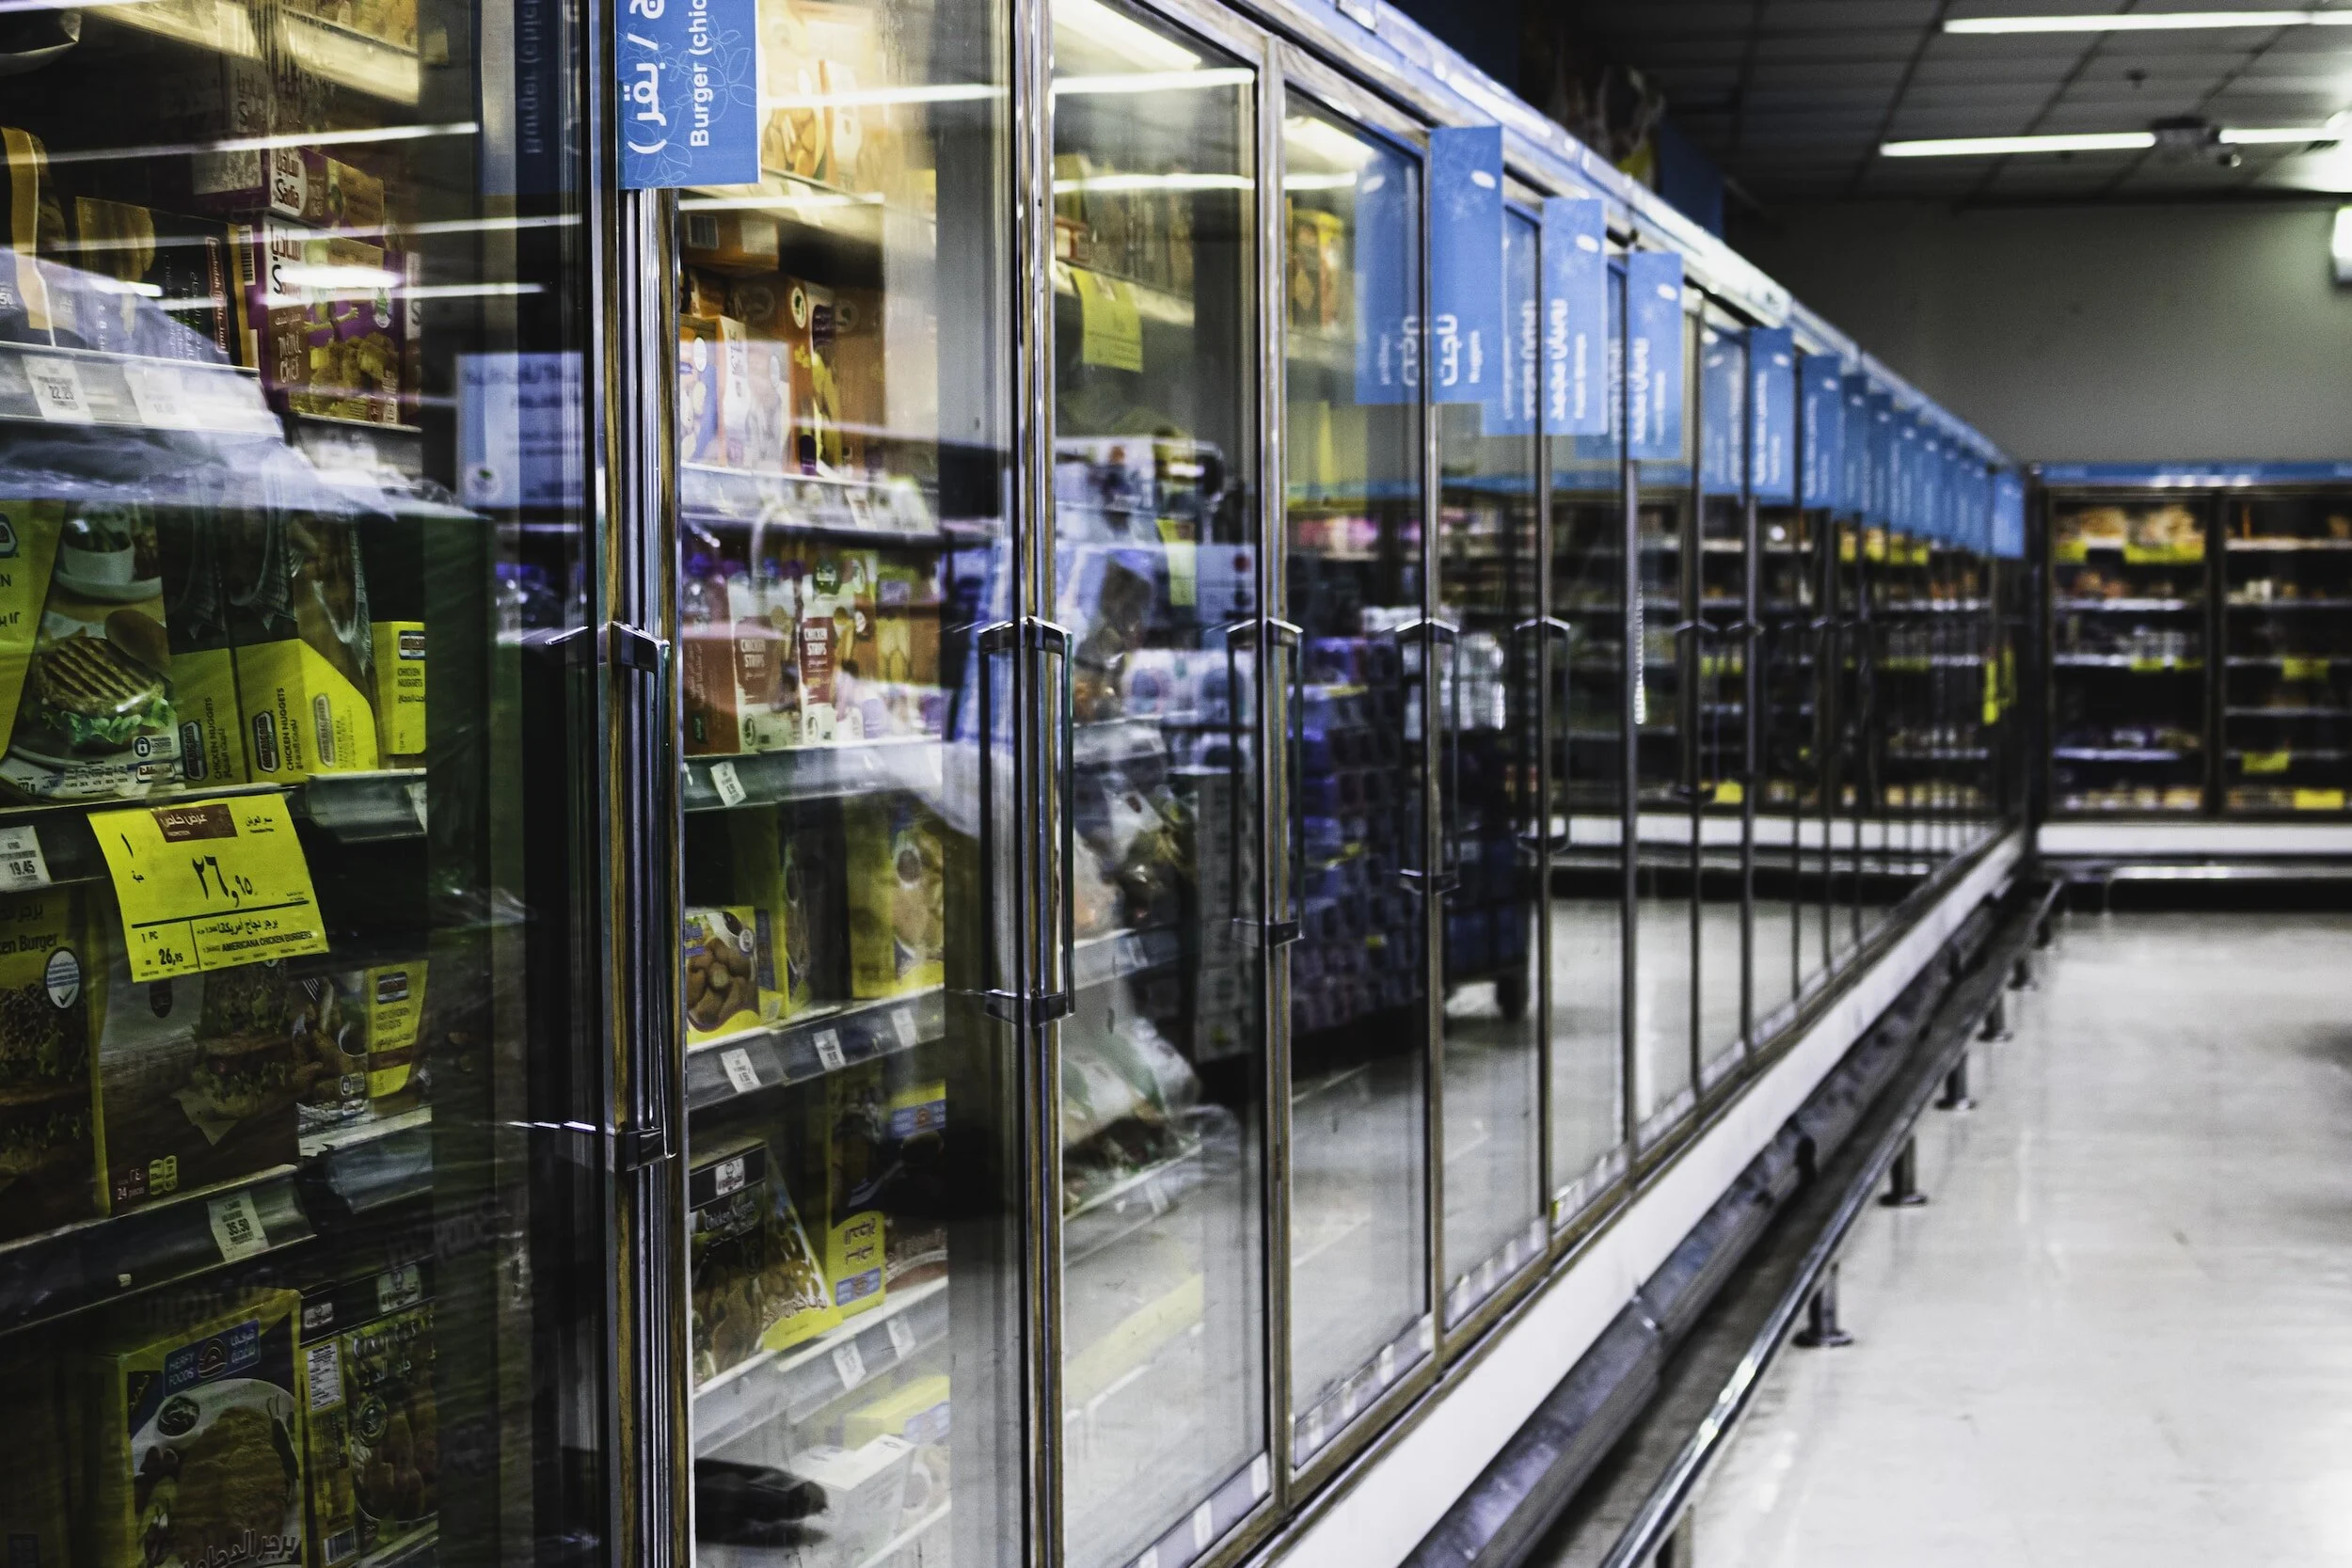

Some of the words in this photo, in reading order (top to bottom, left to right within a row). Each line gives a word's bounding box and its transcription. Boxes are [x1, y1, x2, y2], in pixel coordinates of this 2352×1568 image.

[624, 63, 667, 127] بقر
[691, 62, 713, 147] Burger
[277, 688, 289, 730] NUGGETS
[282, 733, 294, 771] CHICKEN
[160, 813, 184, 828] خاص
[183, 813, 207, 825] عرض
[9, 860, 36, 876] 19.45
[19, 932, 58, 954] Burger
[226, 1218, 251, 1237] 35.50
[256, 1534, 300, 1561] برجر
